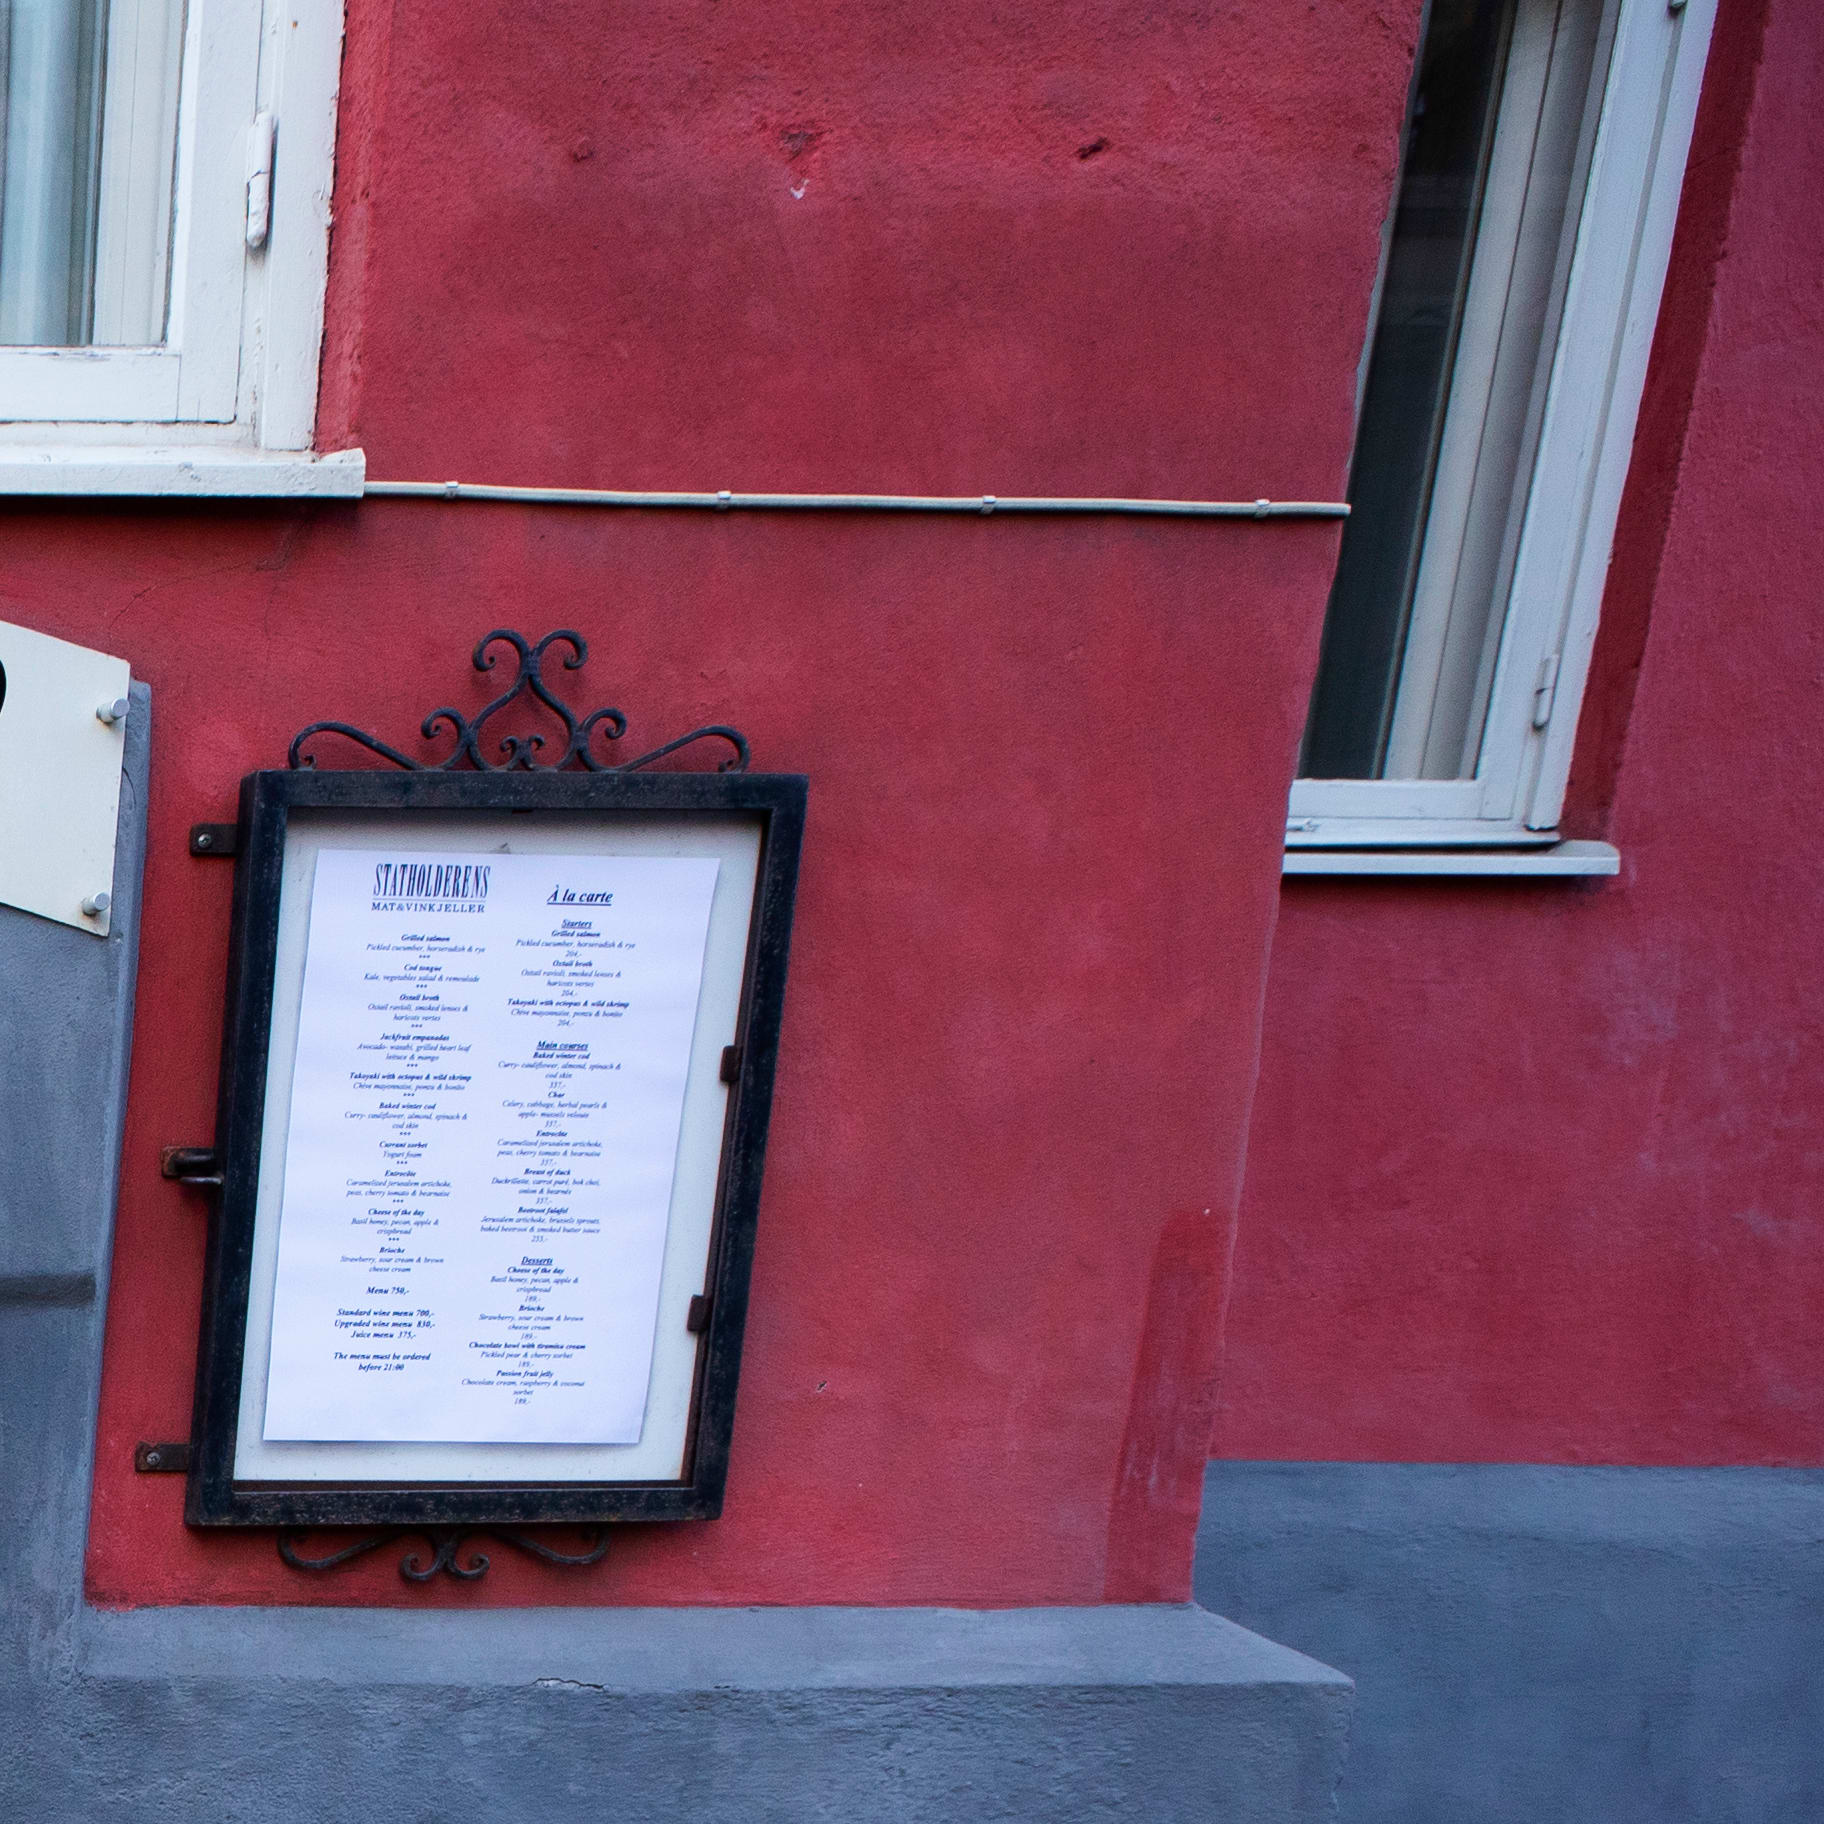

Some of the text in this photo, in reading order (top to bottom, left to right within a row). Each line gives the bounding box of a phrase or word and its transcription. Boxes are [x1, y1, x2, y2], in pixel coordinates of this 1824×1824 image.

[373, 863, 491, 899] STATHOLDERENS
[547, 884, 614, 903] À la carte
[371, 902, 485, 913] MAT&VINKJELLER
[561, 919, 592, 929] Starters
[380, 1033, 411, 1042] Jackfruit
[536, 1040, 557, 1050] Main
[521, 1256, 553, 1266] Desserts
[366, 1286, 389, 1294] Menu
[337, 1308, 372, 1316] Standard
[334, 1319, 371, 1329] Upgraded
[351, 1331, 371, 1339] Juice
[334, 1352, 347, 1360] The
[358, 1363, 405, 1372] before 21:00
